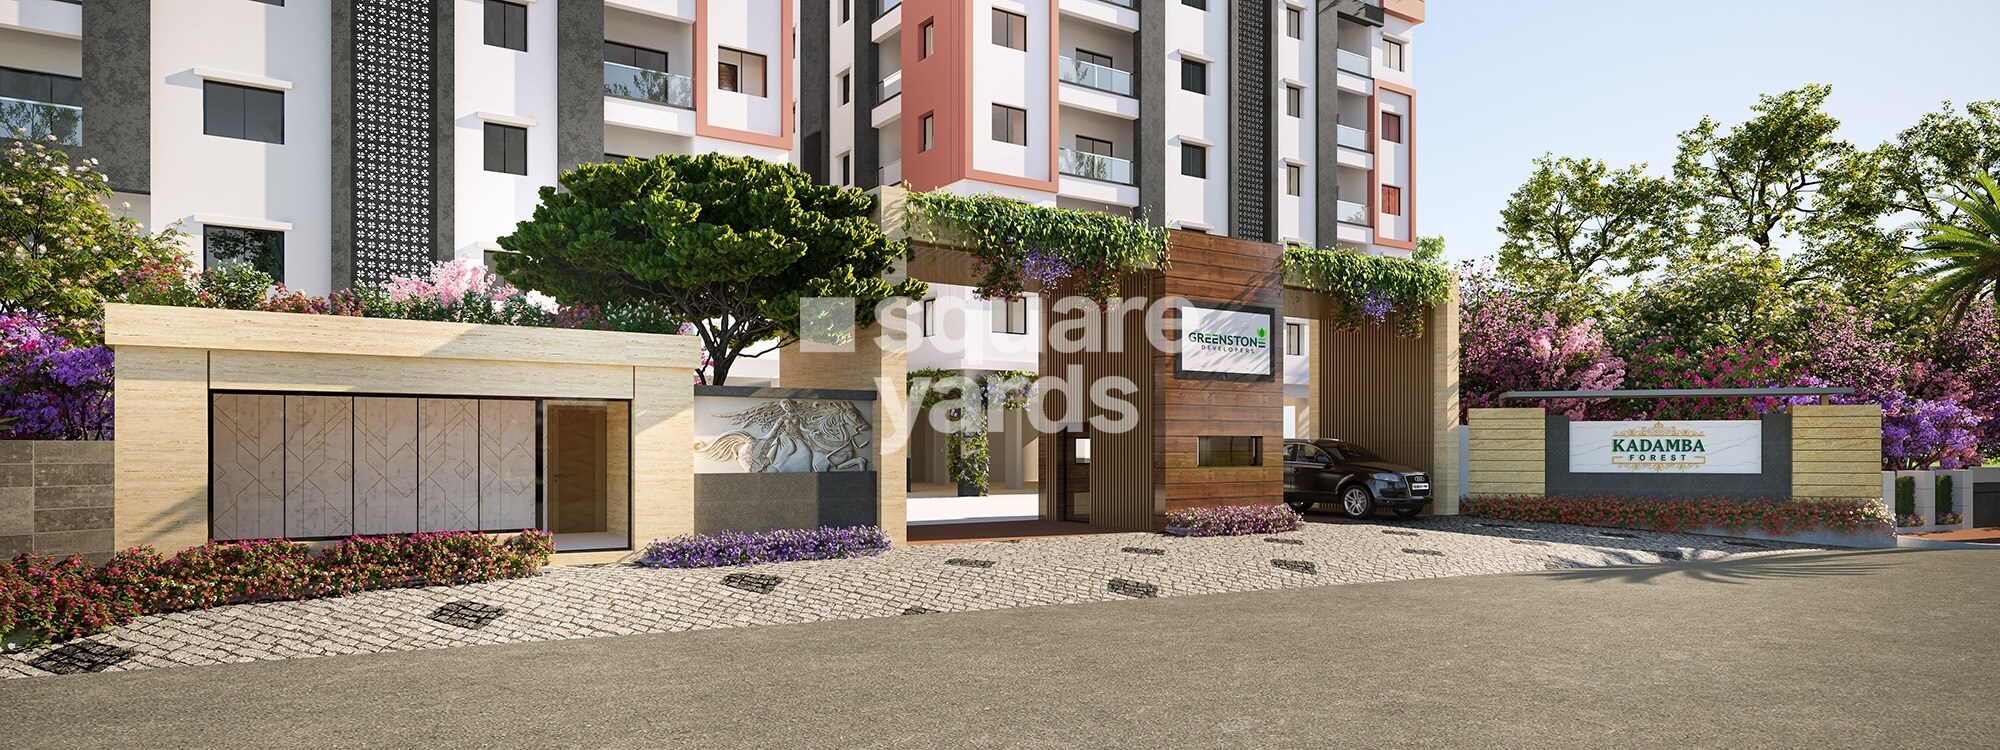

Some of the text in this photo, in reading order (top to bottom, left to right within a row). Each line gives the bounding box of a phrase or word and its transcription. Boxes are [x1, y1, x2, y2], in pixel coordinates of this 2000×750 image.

[1188, 332, 1266, 348] GREENSTONE
[1201, 345, 1255, 354] DEVELOPERS
[1612, 439, 1706, 453] KADAMBA
[1629, 454, 1687, 462] FOREST
